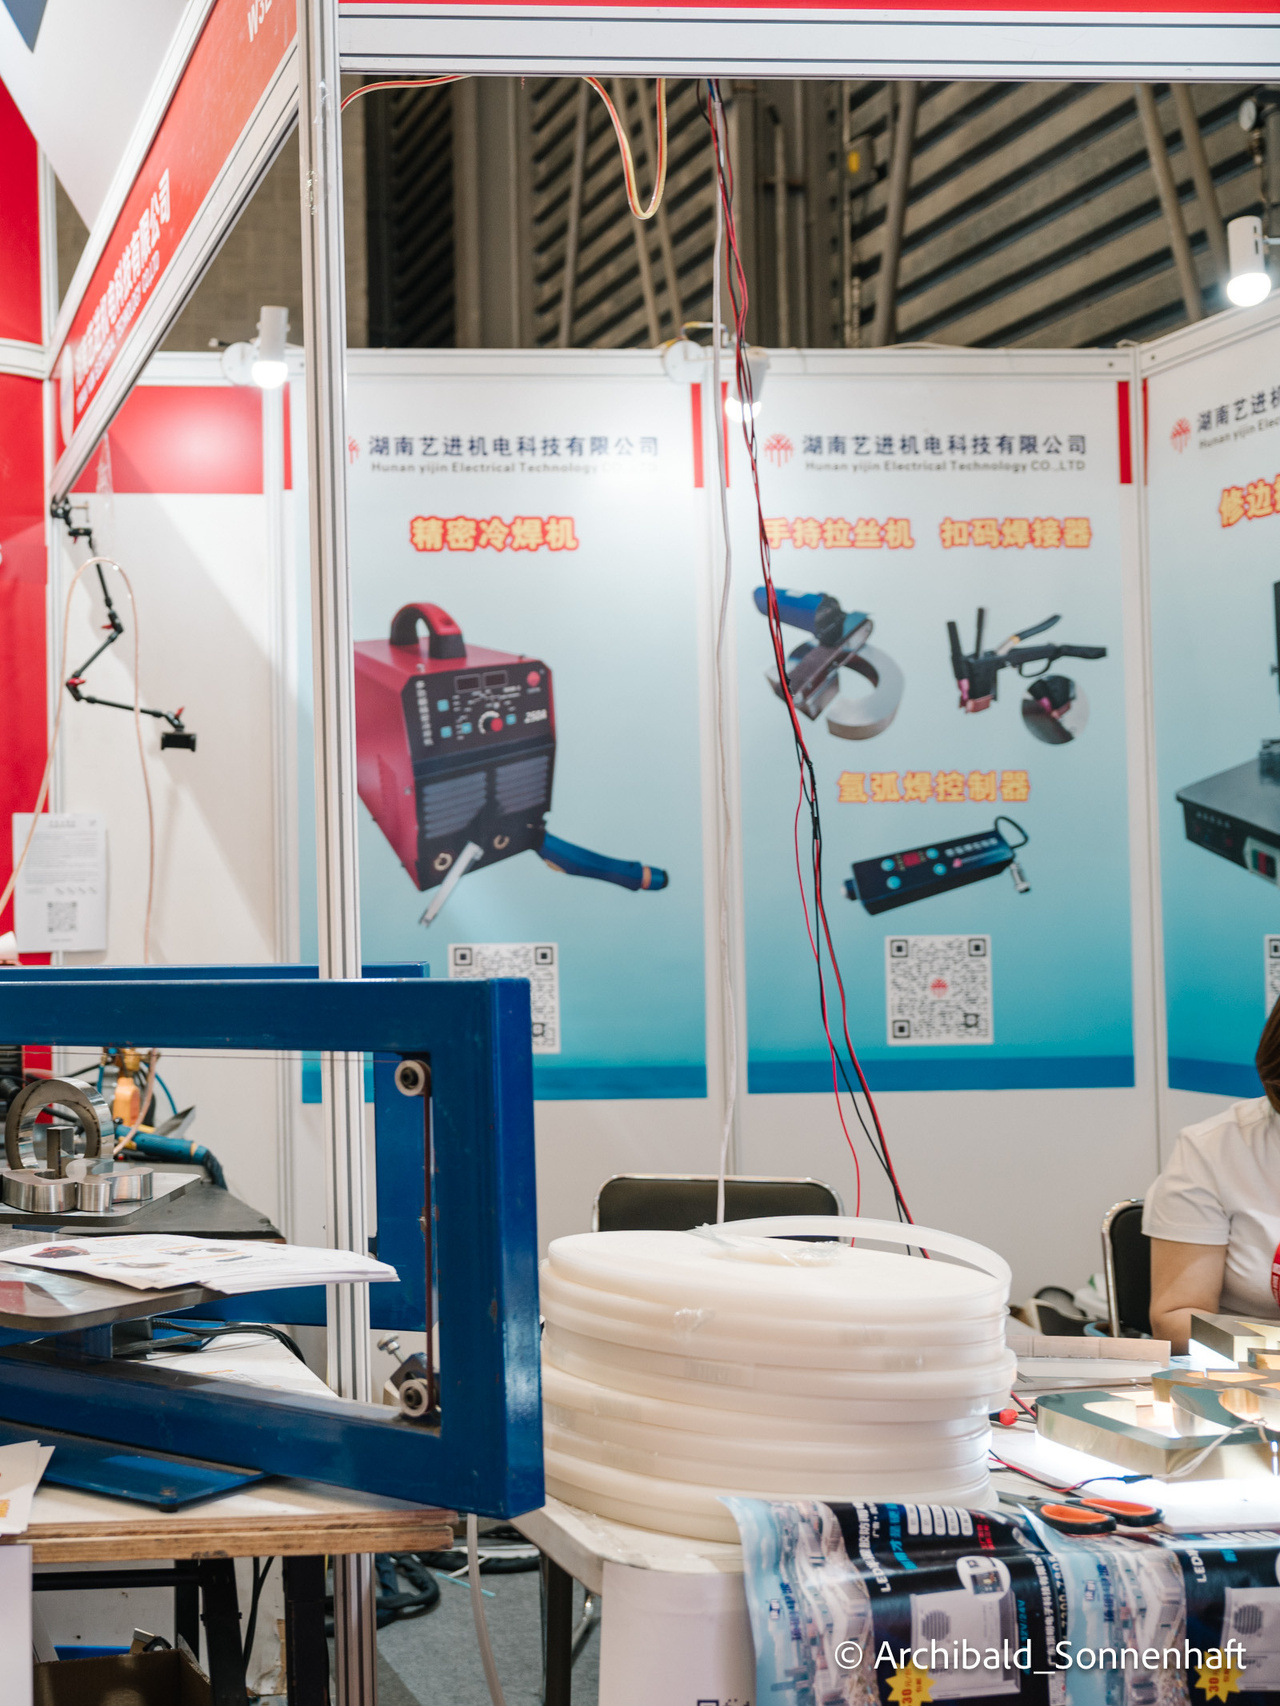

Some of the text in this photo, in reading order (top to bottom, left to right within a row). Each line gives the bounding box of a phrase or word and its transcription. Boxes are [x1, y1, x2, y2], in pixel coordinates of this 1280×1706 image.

[369, 435, 659, 457] 湖南艺进机电科技有限公司
[802, 434, 1087, 456] 湖南艺进机电科技有限公司
[371, 462, 416, 473] Hunan
[419, 462, 449, 474] yijin
[451, 462, 516, 473] Electrical
[519, 462, 599, 474] Technology
[805, 460, 849, 472] Hunan
[851, 460, 881, 473] yijin
[883, 460, 947, 472] Electrical
[950, 460, 1028, 473] Technology
[1218, 474, 1280, 528] 修边
[410, 515, 579, 551] 精密冷焊机
[762, 517, 915, 549] 手持拉丝机
[939, 517, 1092, 549] 扣码焊接器
